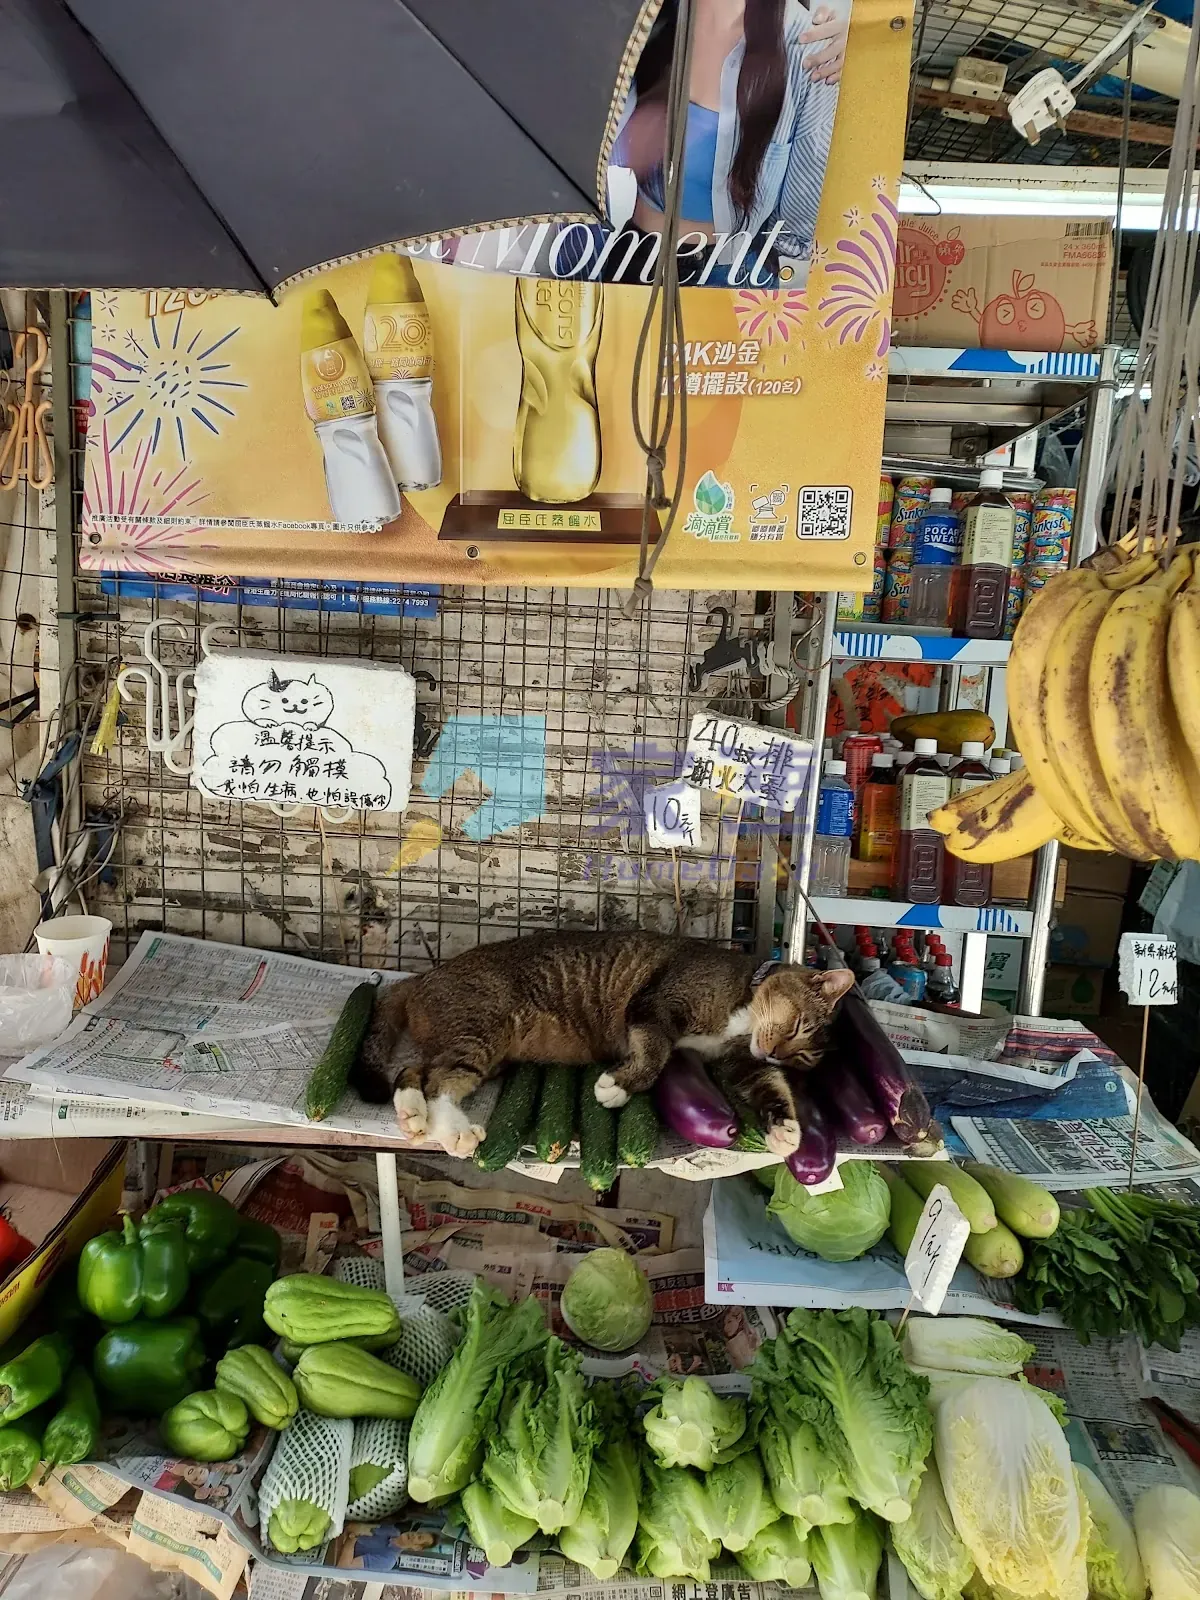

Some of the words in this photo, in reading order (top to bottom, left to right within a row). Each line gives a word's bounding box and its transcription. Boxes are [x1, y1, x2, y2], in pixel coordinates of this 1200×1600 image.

[502, 512, 597, 528] 屈臣氏蒸餾水
